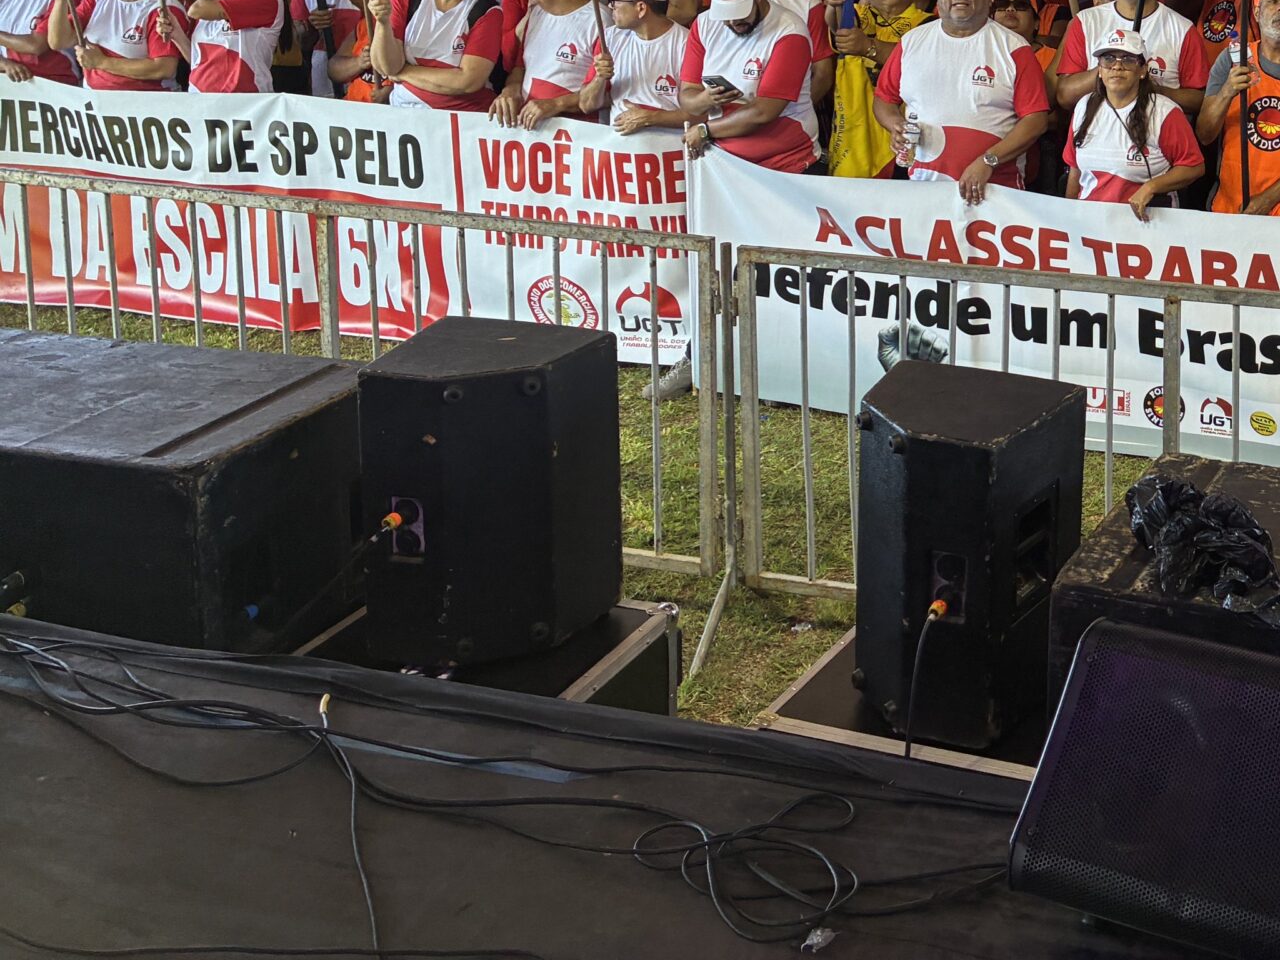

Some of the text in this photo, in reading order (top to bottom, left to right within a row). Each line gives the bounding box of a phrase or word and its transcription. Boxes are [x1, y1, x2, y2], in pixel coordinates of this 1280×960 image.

[208, 118, 259, 174] DE
[269, 120, 321, 177] SP
[329, 125, 425, 189] PELO
[478, 129, 573, 195] VOCÊ
[481, 201, 569, 252] TEMPO
[577, 210, 645, 258] PARA
[815, 206, 853, 247] A
[855, 215, 1070, 274] CLASSE
[735, 263, 991, 336] defende
[1011, 303, 1115, 351] um
